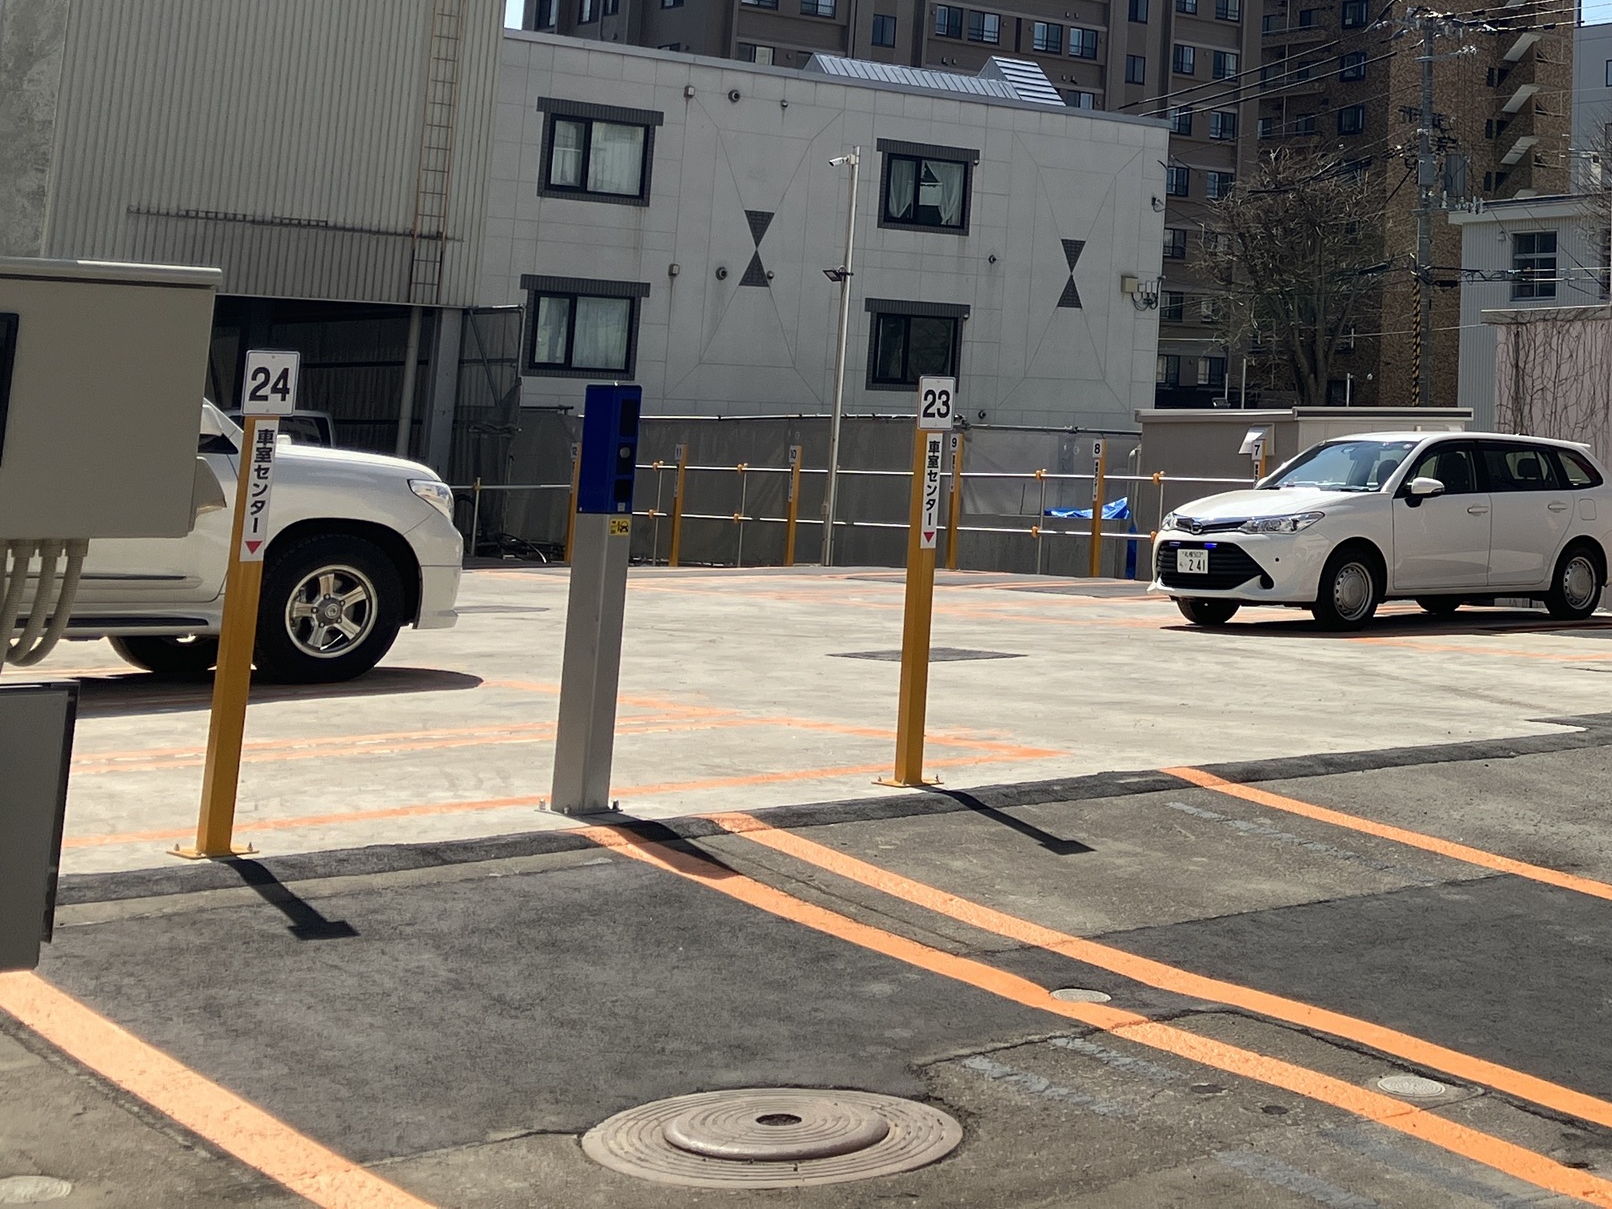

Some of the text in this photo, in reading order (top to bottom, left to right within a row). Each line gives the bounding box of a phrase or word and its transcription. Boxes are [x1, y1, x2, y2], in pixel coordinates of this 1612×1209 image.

[249, 366, 290, 402] 24
[922, 388, 950, 419] 23
[951, 437, 957, 448] 9
[1094, 443, 1101, 454] 8
[1254, 444, 1260, 456] 7
[250, 428, 275, 534] 車室センター
[925, 440, 940, 526] 車室センター
